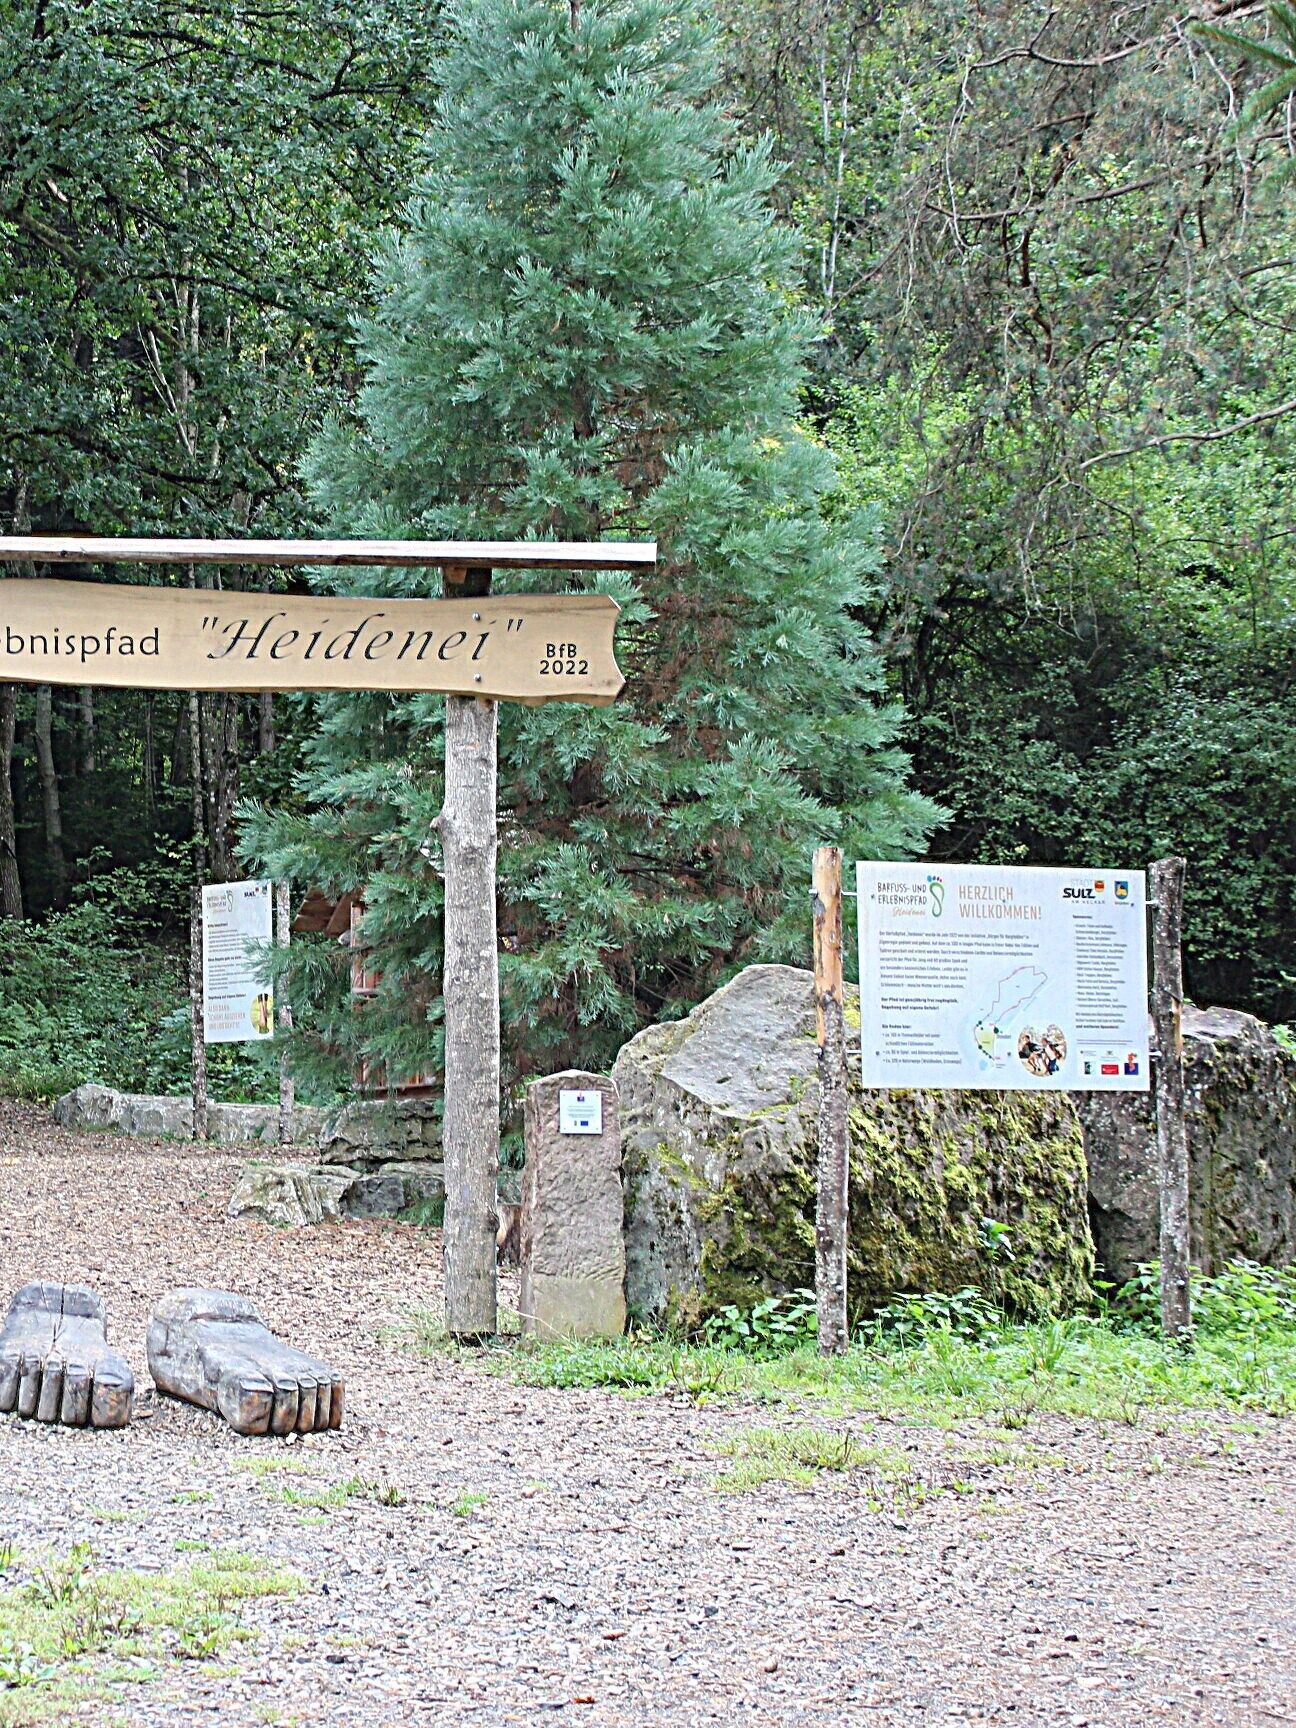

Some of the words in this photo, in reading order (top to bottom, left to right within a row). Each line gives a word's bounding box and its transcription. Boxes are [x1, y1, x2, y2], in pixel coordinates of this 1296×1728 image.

[200, 611, 525, 661] "Heidenei"
[546, 642, 578, 658] BfB
[538, 659, 589, 676] 2022
[877, 882, 910, 893] BARFUSS-
[912, 883, 927, 893] UND
[958, 885, 1014, 901] HERZLICH
[1062, 887, 1096, 899] SULZ
[878, 894, 928, 906] ERLEBNISPFAD
[959, 903, 1042, 920] WILLKOMMEN!
